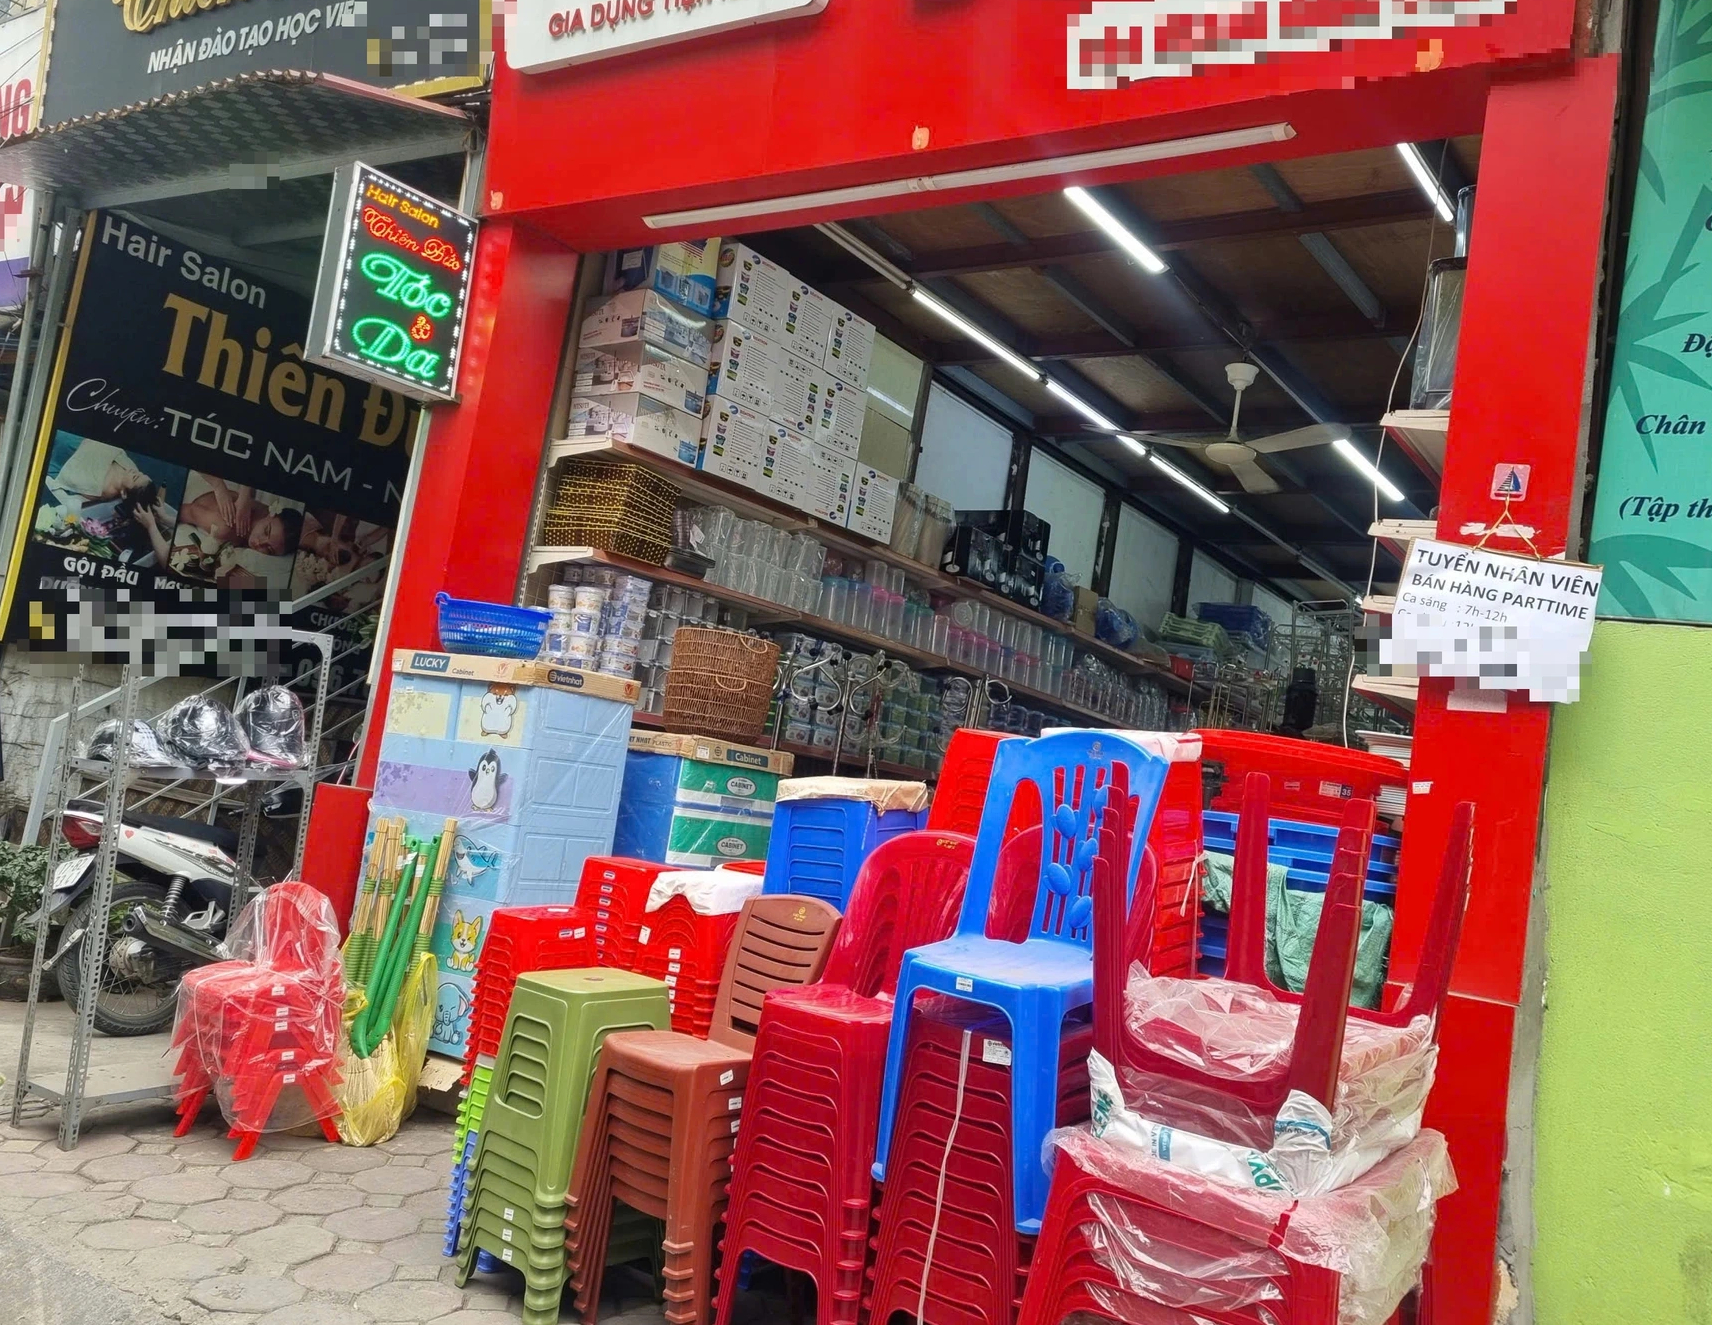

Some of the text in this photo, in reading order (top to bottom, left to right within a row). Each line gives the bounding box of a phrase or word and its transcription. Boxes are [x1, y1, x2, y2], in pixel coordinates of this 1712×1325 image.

[147, 38, 198, 74] NHẬN
[198, 26, 237, 61] ĐÀO
[238, 20, 274, 56] TẠO
[275, 8, 322, 45] HỌC
[549, 9, 585, 37] GIA
[363, 206, 420, 252] Thiên
[366, 184, 440, 229] Hair Salon
[102, 216, 267, 308] Hair Salon
[360, 252, 452, 318] Tóc
[162, 292, 347, 433] Thiên
[352, 317, 440, 378] Da
[1636, 414, 1706, 435] Chân
[163, 407, 254, 460] TÓC
[263, 441, 352, 491] NAM
[1619, 496, 1680, 522] (Tập
[63, 557, 97, 578] GỘI
[101, 562, 140, 586] ĐẦU
[1417, 549, 1599, 598] TUYỂN NHÂN VIÊN
[1402, 592, 1419, 604] Ca
[1420, 595, 1448, 613] sáng
[1465, 604, 1508, 624] 7h-12h
[1411, 573, 1589, 621] BÁN HÀNG PARTTIME
[413, 655, 447, 670] LUCKY
[451, 667, 474, 677] Cabinet
[735, 752, 762, 765] Cabinet
